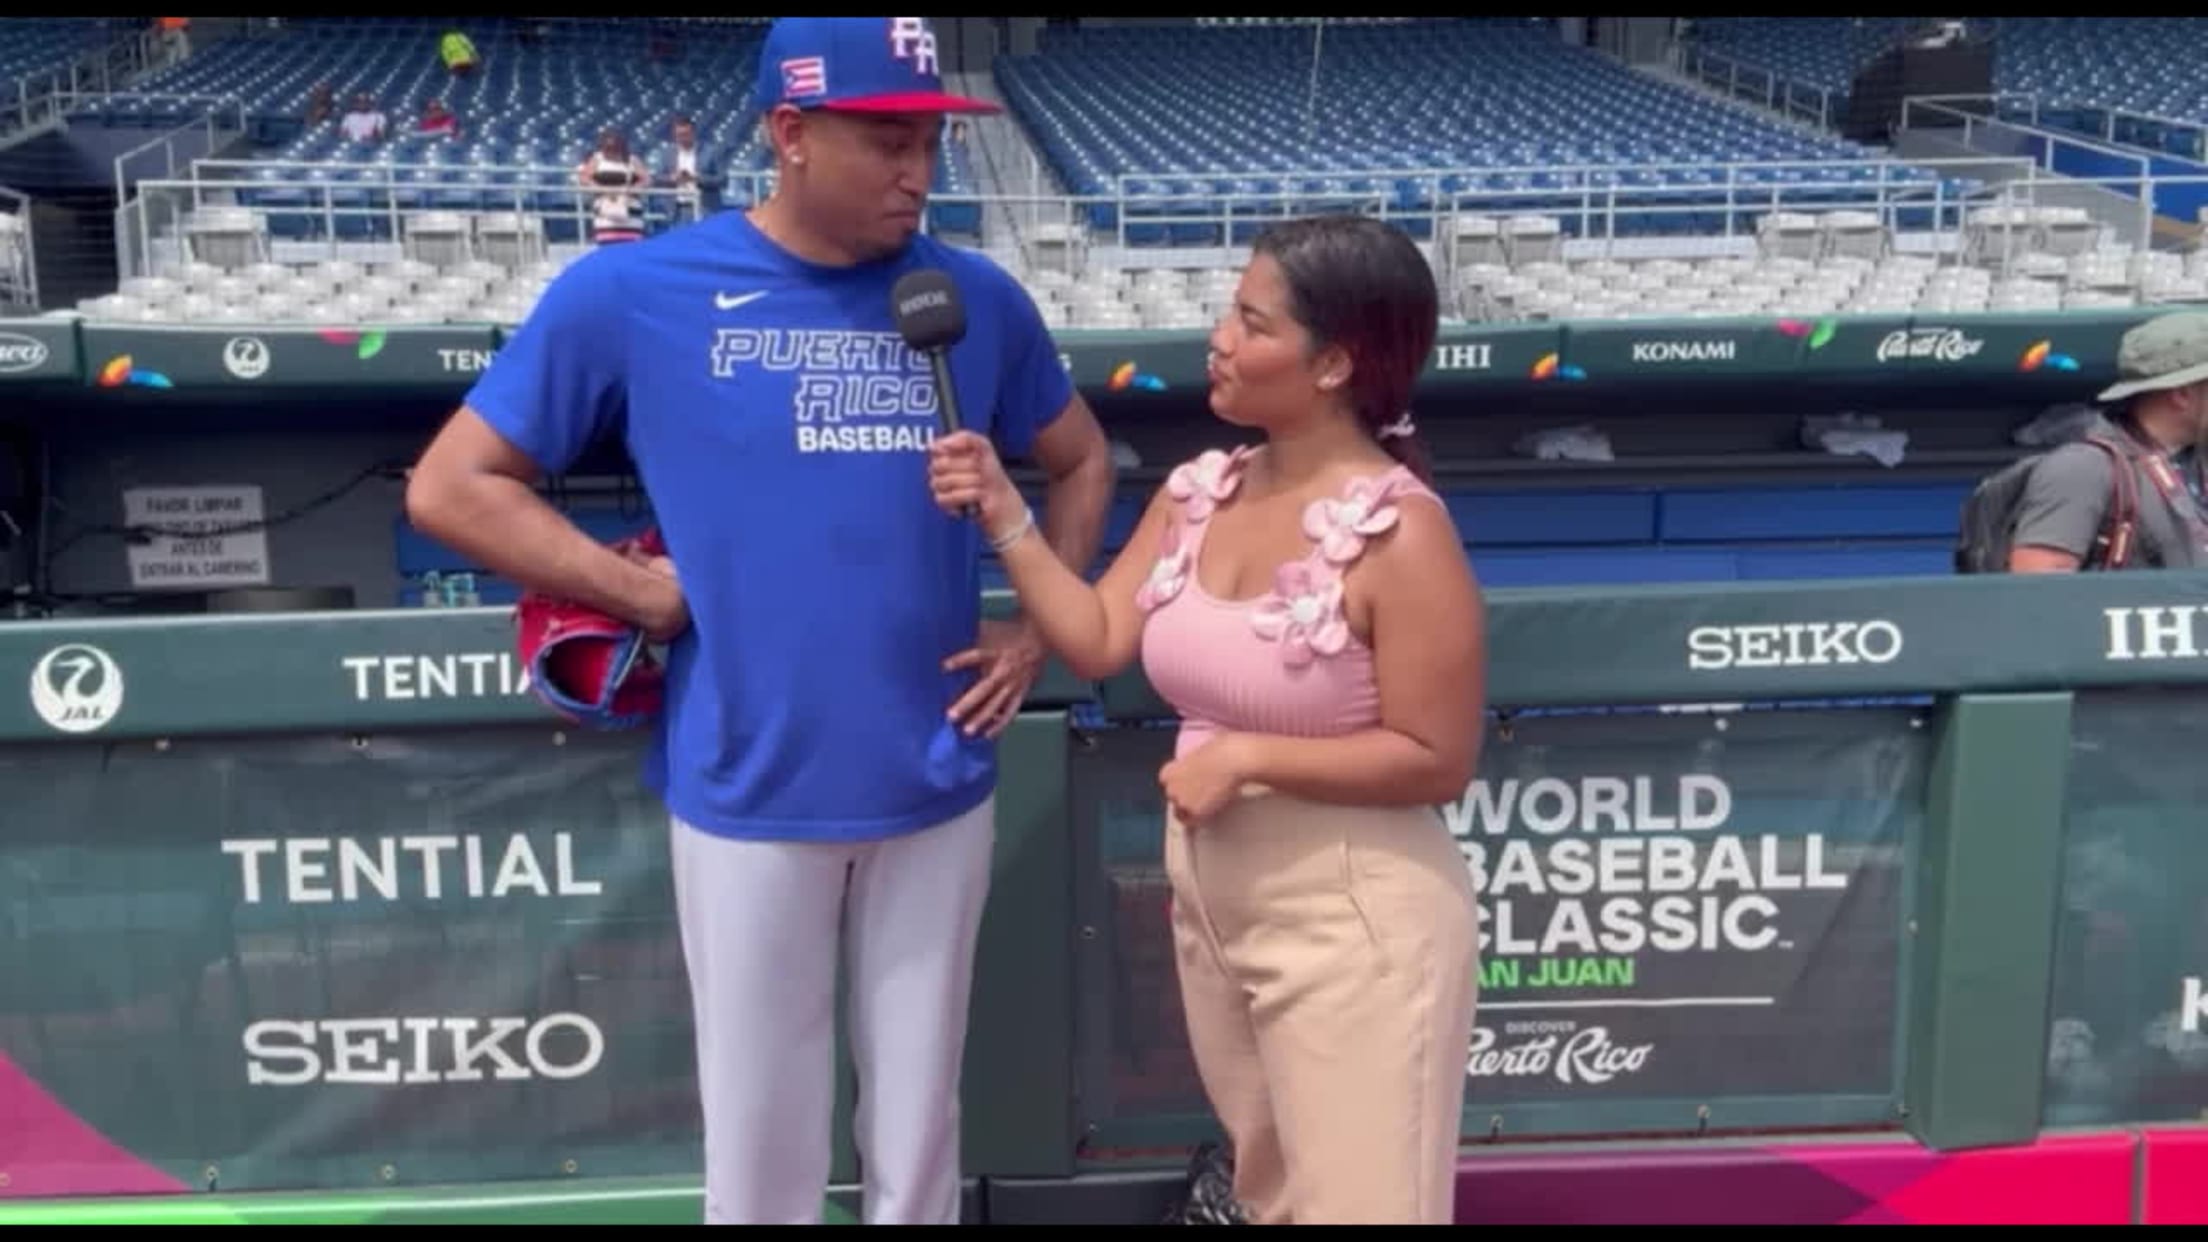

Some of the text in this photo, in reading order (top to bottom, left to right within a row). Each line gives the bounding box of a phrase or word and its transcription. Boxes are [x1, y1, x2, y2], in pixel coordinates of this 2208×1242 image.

[1435, 344, 1493, 370] IHI
[1633, 340, 1736, 362] KONAMI
[794, 374, 940, 423] RICO
[1687, 619, 1904, 670] SEIKO
[2104, 605, 2208, 660] IH
[1442, 773, 1733, 836] WORLD
[221, 832, 604, 903] TENTIAL
[1477, 894, 1780, 955] LASSIC
[1528, 956, 1637, 988] JUAN
[241, 1012, 604, 1085] SEIKO
[1505, 1021, 1576, 1035] DISCOVER
[1555, 1024, 1656, 1085] Rico
